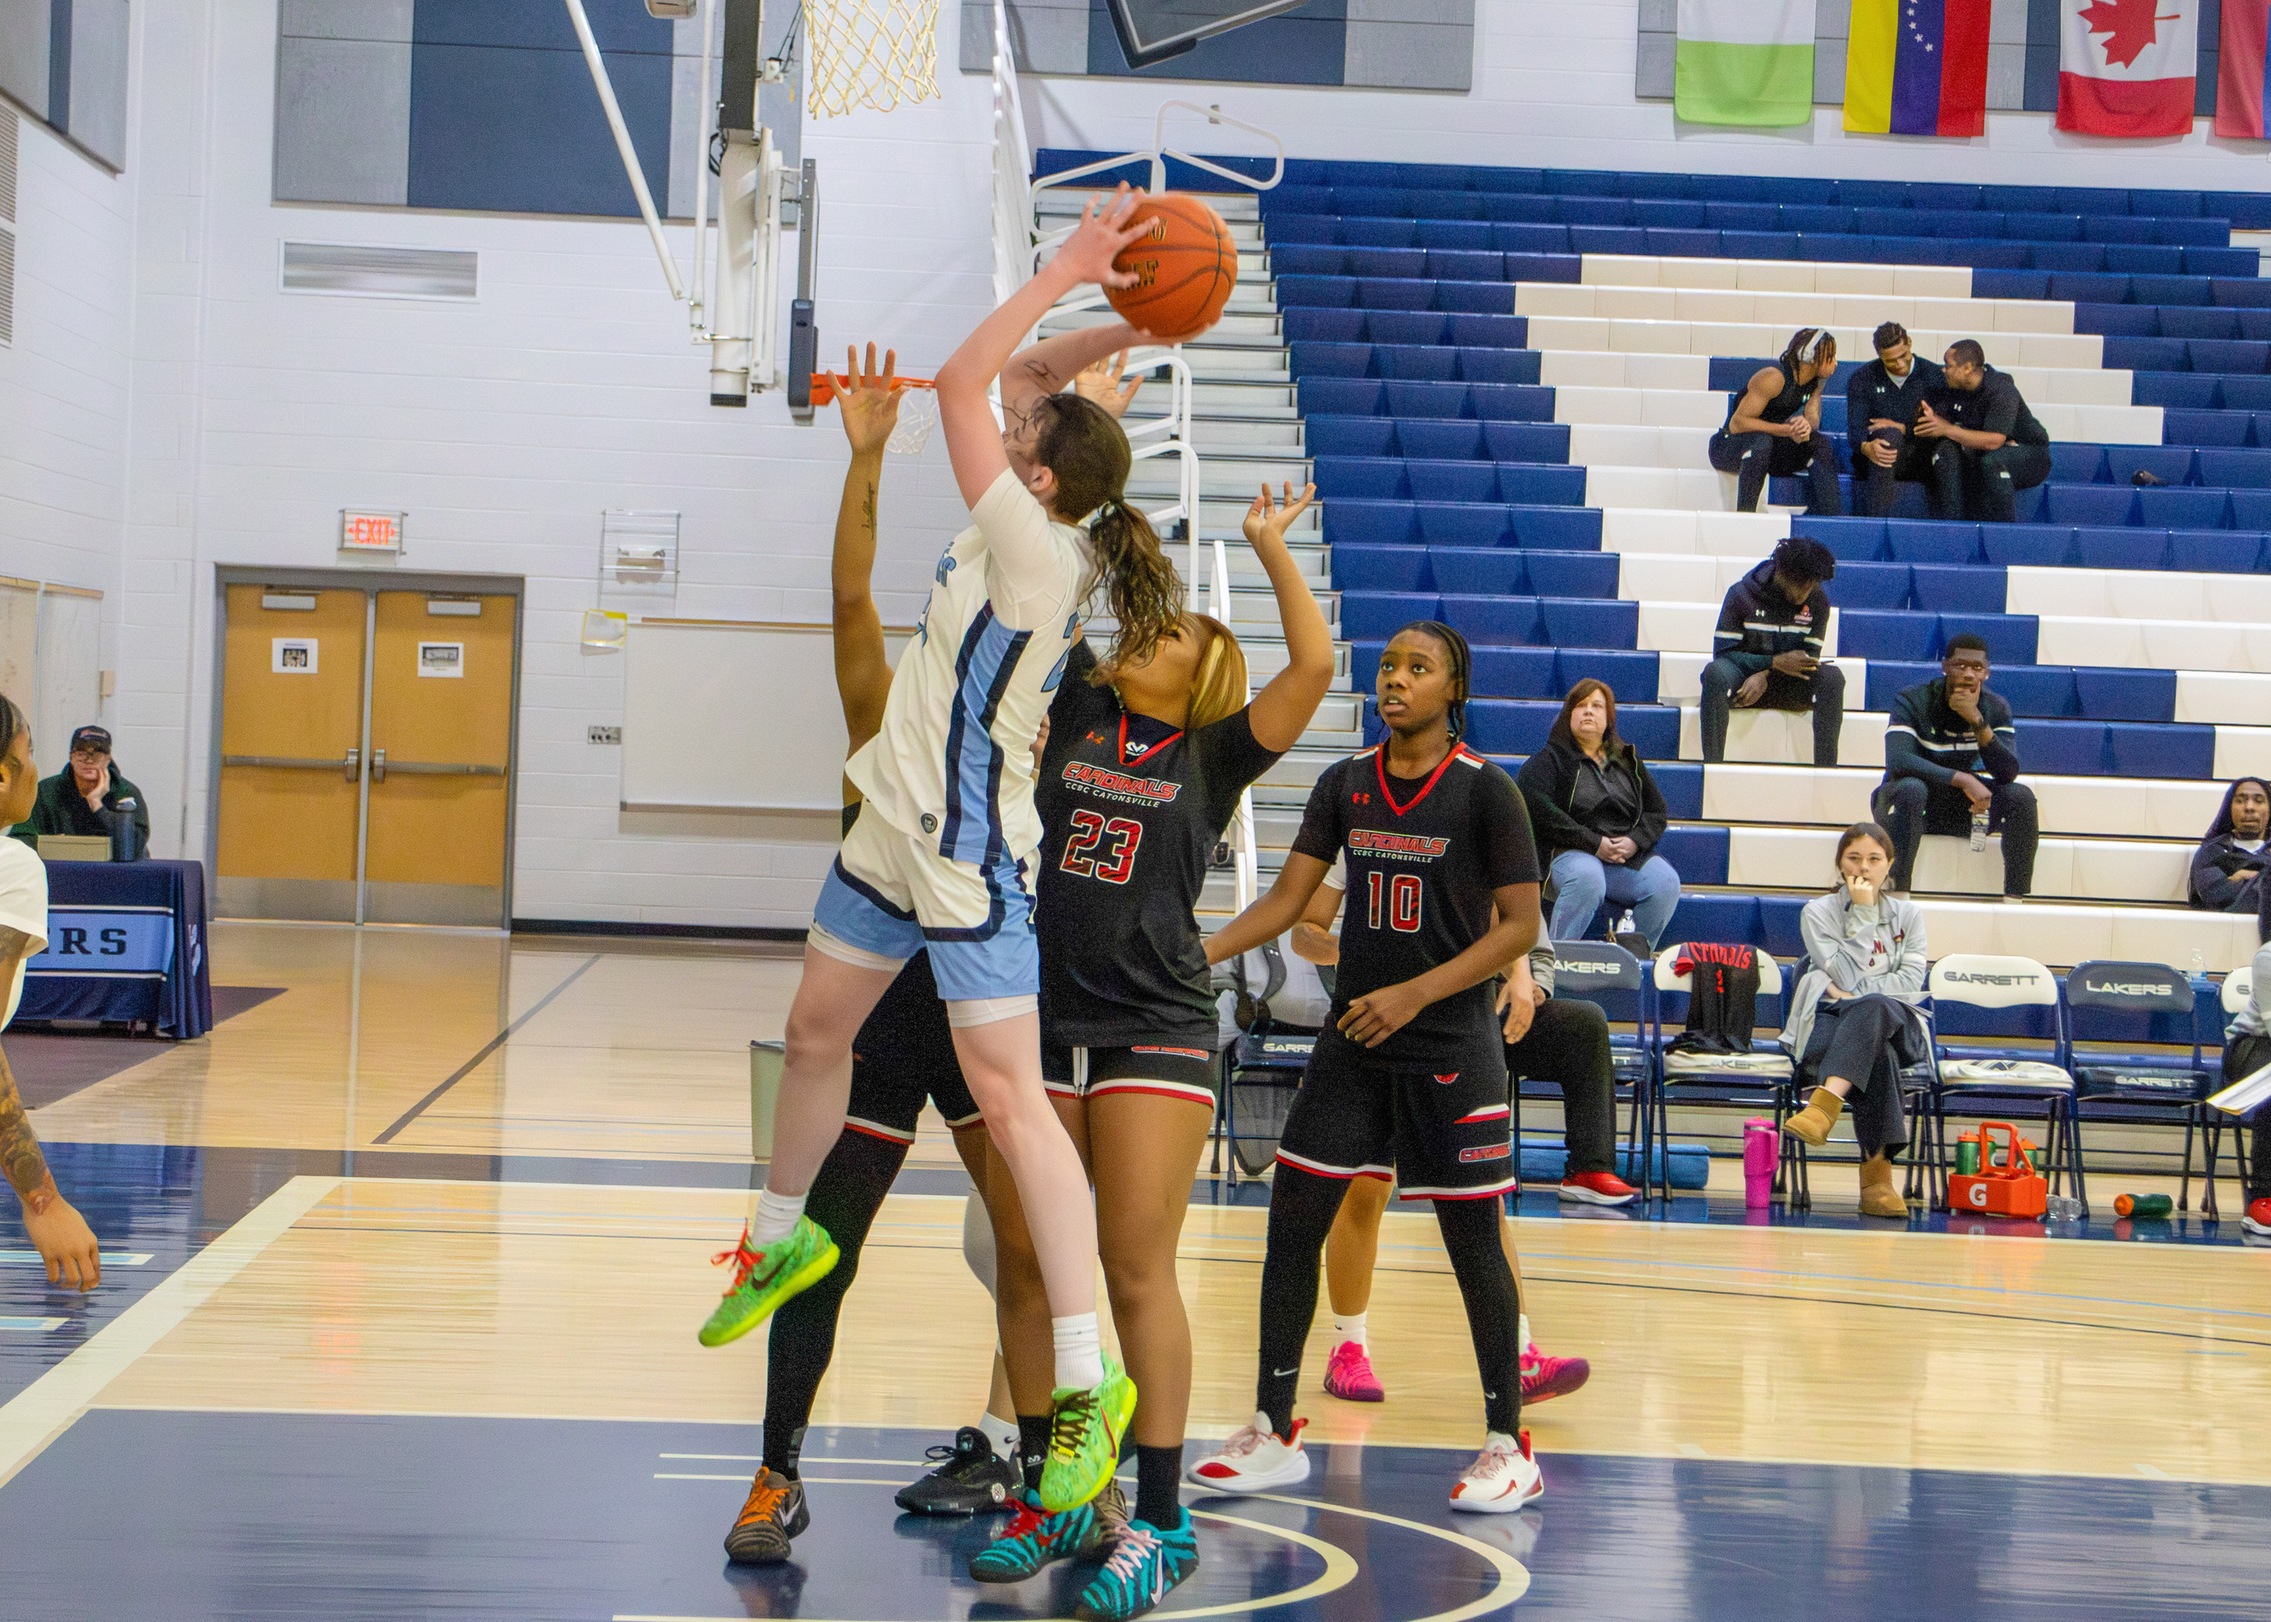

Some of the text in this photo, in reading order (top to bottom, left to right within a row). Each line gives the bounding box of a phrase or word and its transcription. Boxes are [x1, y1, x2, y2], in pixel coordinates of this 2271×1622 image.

[354, 517, 391, 545] EXIT
[1062, 761, 1181, 802] CARDINALS
[1065, 781, 1160, 808] CCBC CATONSVILLE
[1060, 808, 1143, 885] 23
[1349, 829, 1450, 857] CARDINALS
[1375, 852, 1433, 864] CATONSVILLE
[1368, 871, 1422, 933] 10
[1944, 971, 2040, 986] GARRETT
[2086, 980, 2172, 996] LAKERS
[2115, 1075, 2195, 1089] GARRETT
[1968, 1183, 1988, 1207] G
